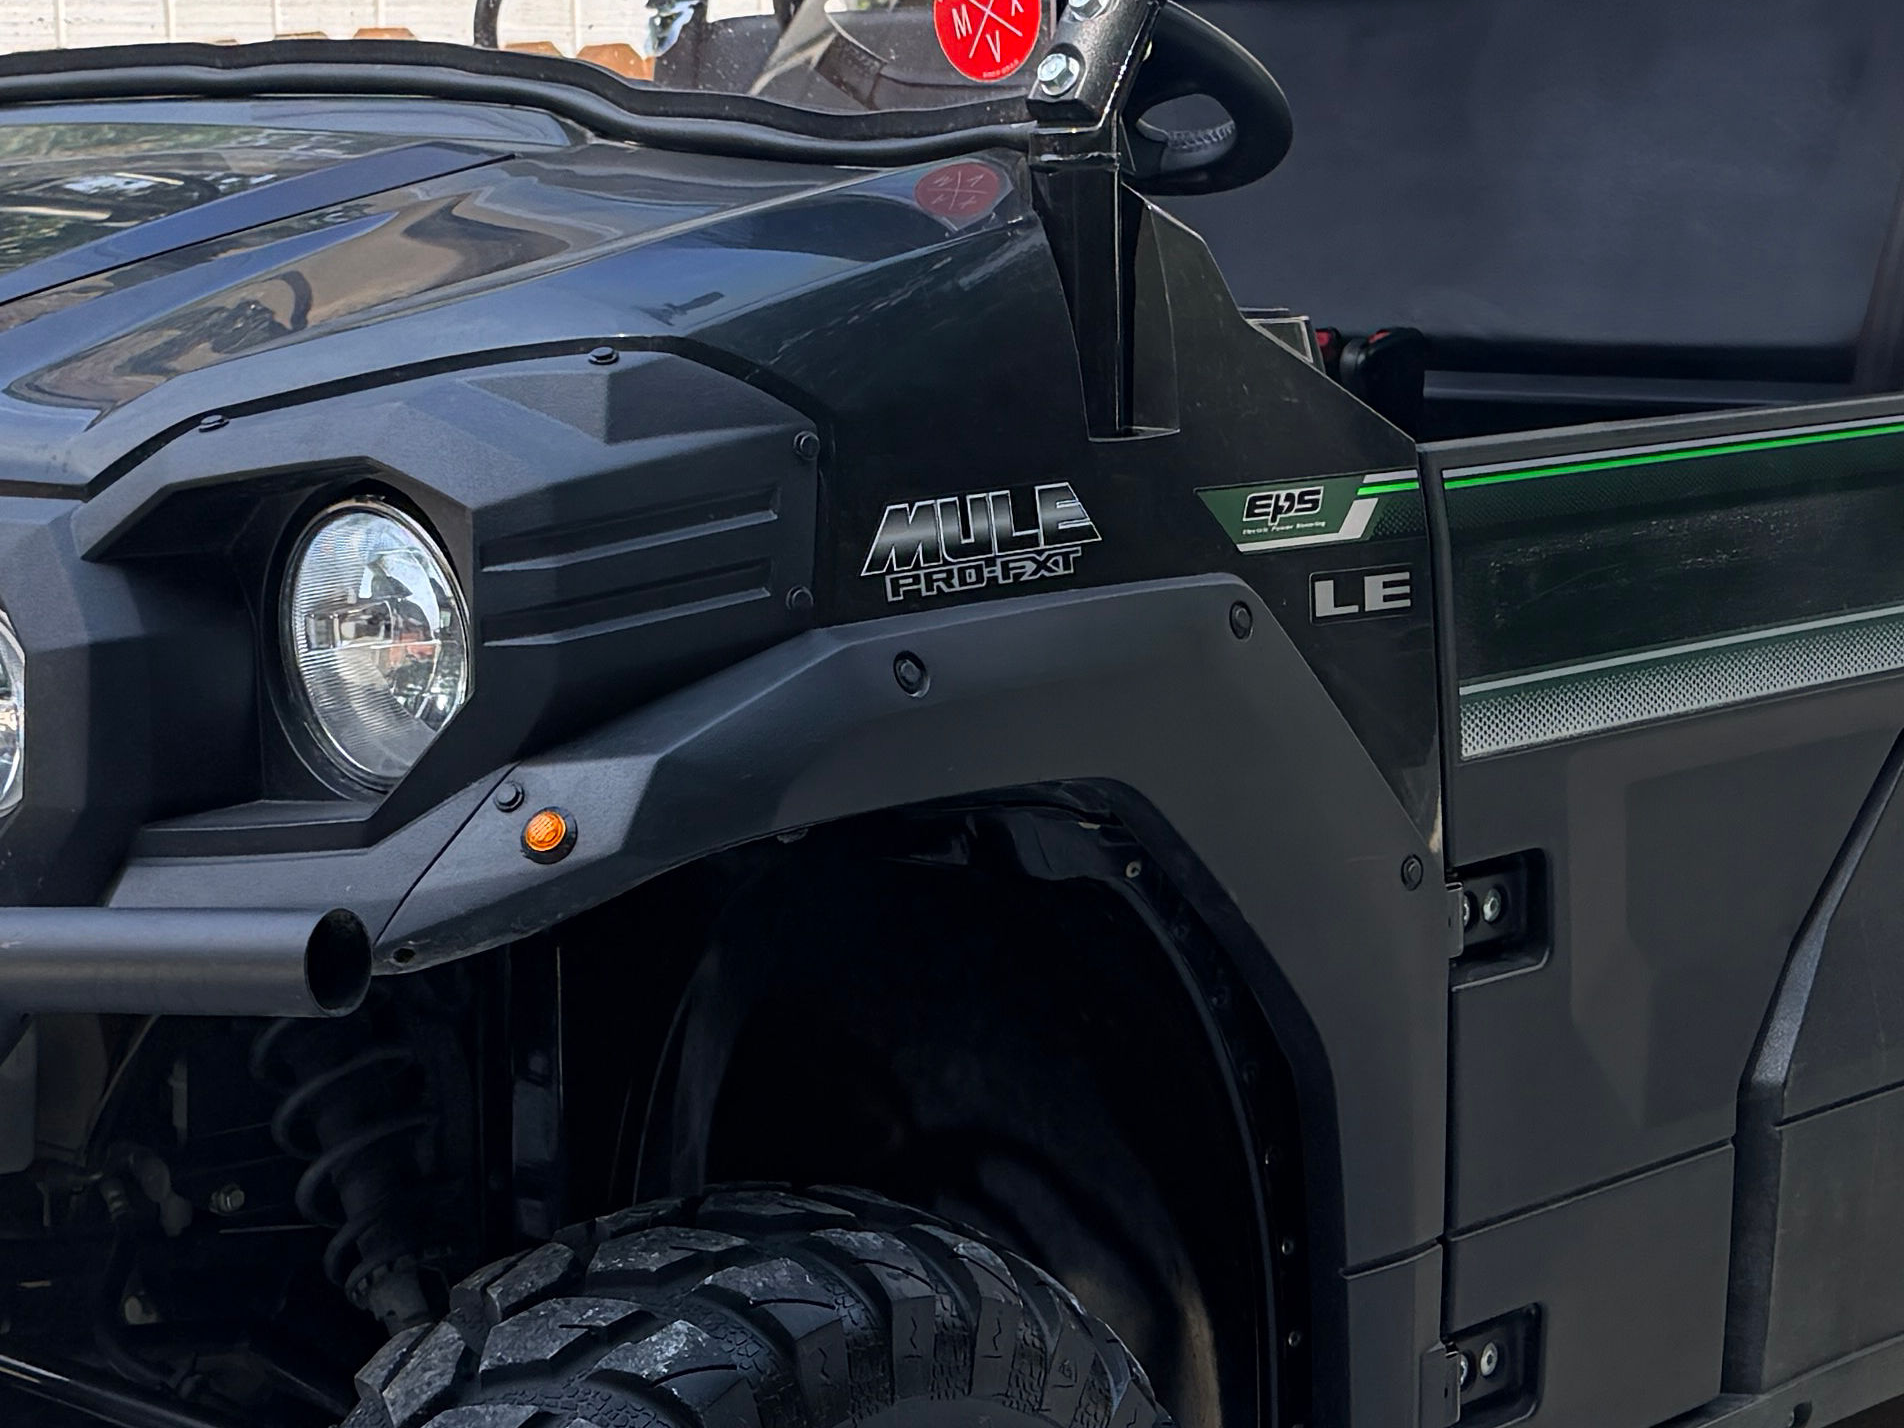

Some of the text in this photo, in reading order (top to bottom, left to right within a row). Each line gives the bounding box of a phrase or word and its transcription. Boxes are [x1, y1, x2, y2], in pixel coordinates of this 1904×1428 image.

[952, 4, 972, 40] M
[985, 30, 1001, 62] V
[860, 481, 1102, 576] MULE
[885, 546, 1082, 601] PRO-FXT
[1314, 572, 1411, 618] LE
